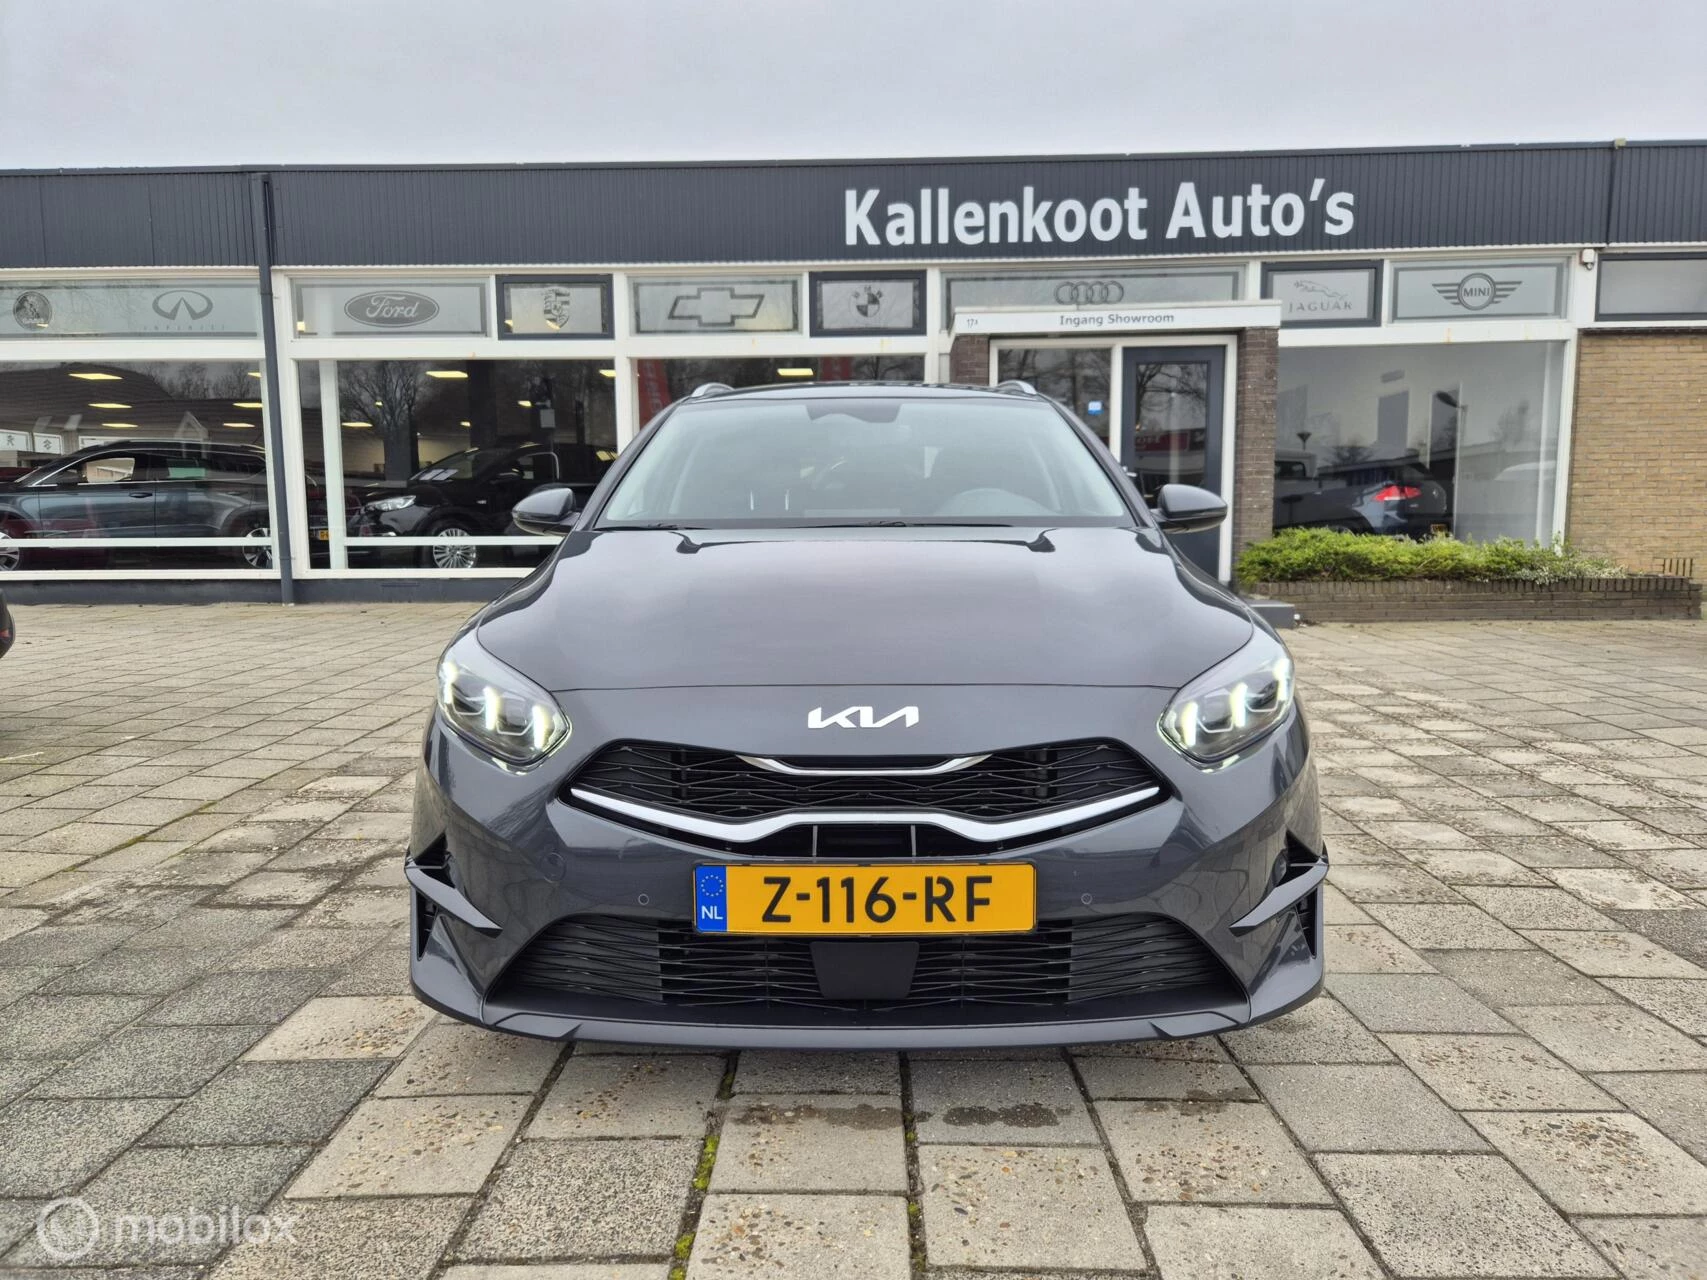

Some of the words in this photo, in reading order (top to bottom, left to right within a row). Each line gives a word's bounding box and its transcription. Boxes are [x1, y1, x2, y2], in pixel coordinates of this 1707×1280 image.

[845, 186, 1148, 246] Kallenkoot
[1166, 178, 1355, 240] Auto's
[1463, 287, 1490, 297] MINI
[366, 295, 420, 318] Ford
[1288, 301, 1352, 313] JAGUAR
[1060, 315, 1104, 327] Ingang
[1107, 313, 1175, 324] Showroom
[761, 875, 993, 924] Z-116-RF
[701, 905, 724, 921] NL
